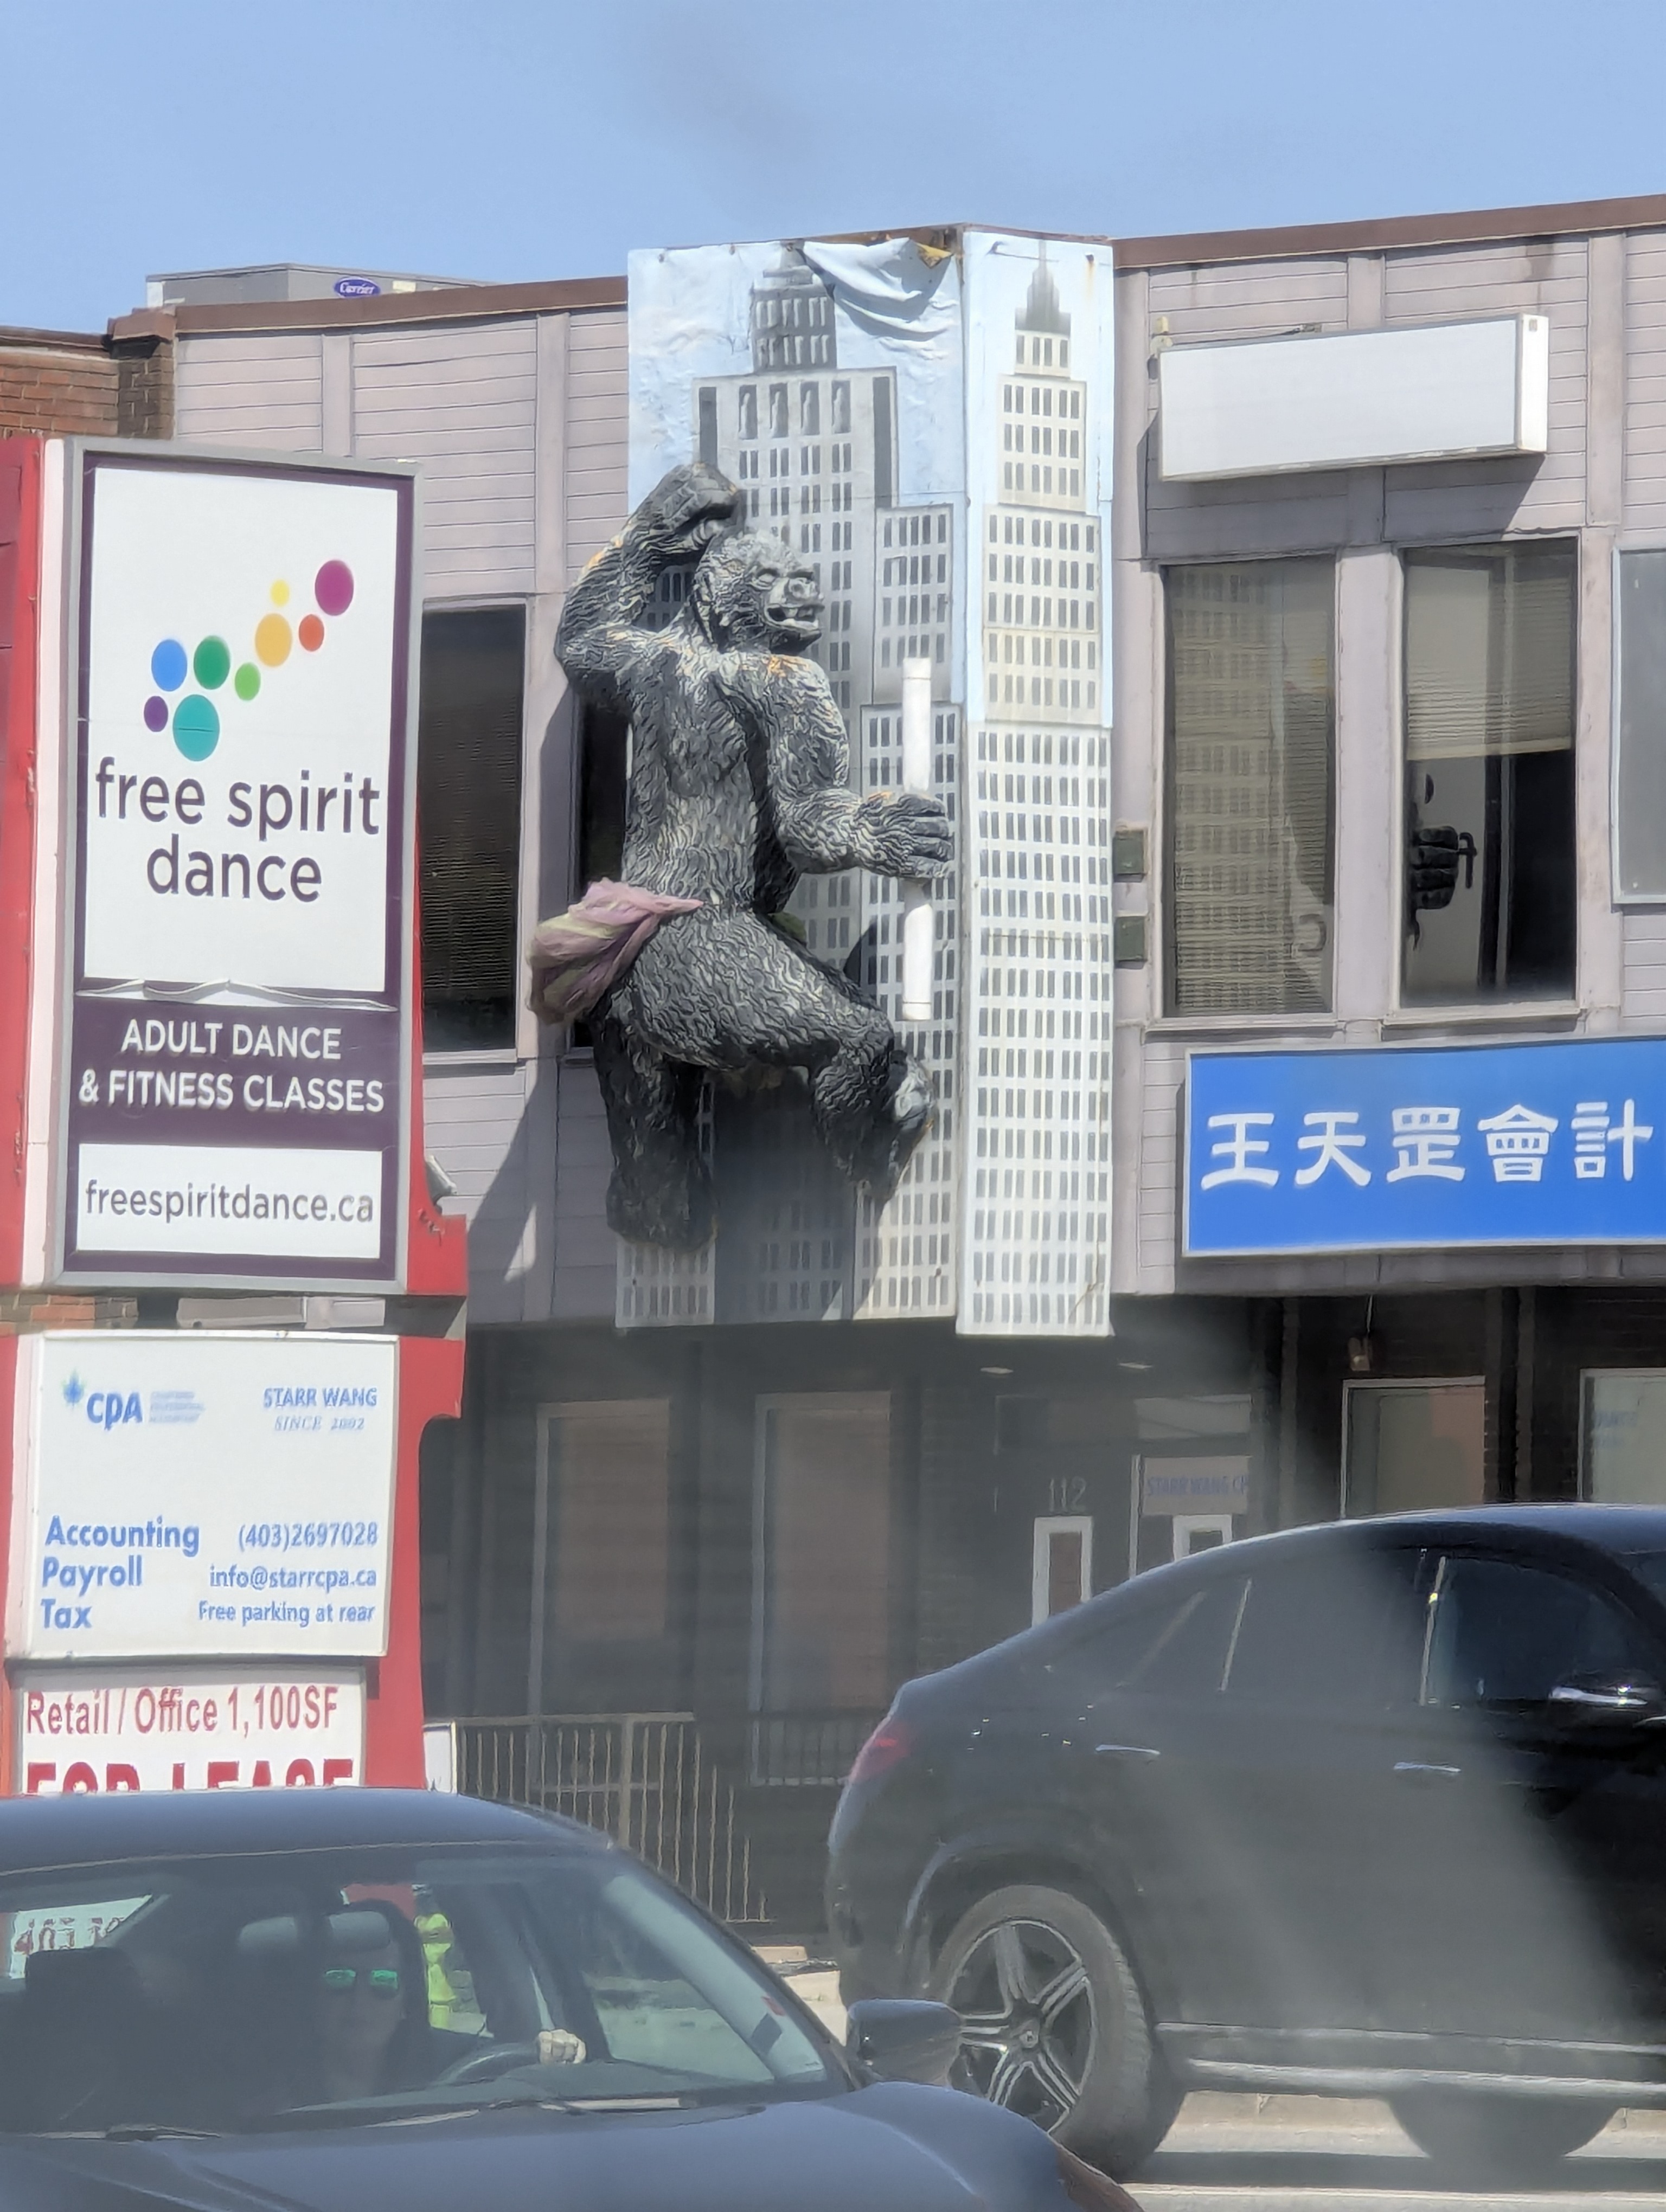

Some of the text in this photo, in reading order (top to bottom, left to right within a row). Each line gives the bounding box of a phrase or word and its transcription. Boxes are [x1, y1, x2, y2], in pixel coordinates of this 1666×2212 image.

[95, 757, 380, 841] free spirit
[147, 833, 322, 902] dance
[120, 1019, 342, 1060] ADULT DANCE
[79, 1070, 384, 1113] & FITNESS CLASSES
[1200, 1098, 1655, 1190] 王天罡會計
[85, 1179, 374, 1224] freespiritdance.ca
[86, 1391, 143, 1431] CPA
[264, 1387, 377, 1408] STARR WANG
[275, 1416, 322, 1431] SINCE
[1049, 1476, 1087, 1513] 112
[45, 1515, 200, 1557] Accounting
[239, 1522, 378, 1552] (403)2697028
[42, 1554, 142, 1597] Payroll
[209, 1564, 377, 1594] info@starrcpa.ca
[41, 1598, 92, 1629] Tax
[198, 1600, 376, 1628] Free parking at rear
[28, 1688, 108, 1734] Retail
[134, 1687, 217, 1733] Office
[227, 1685, 339, 1738] 1,100SF
